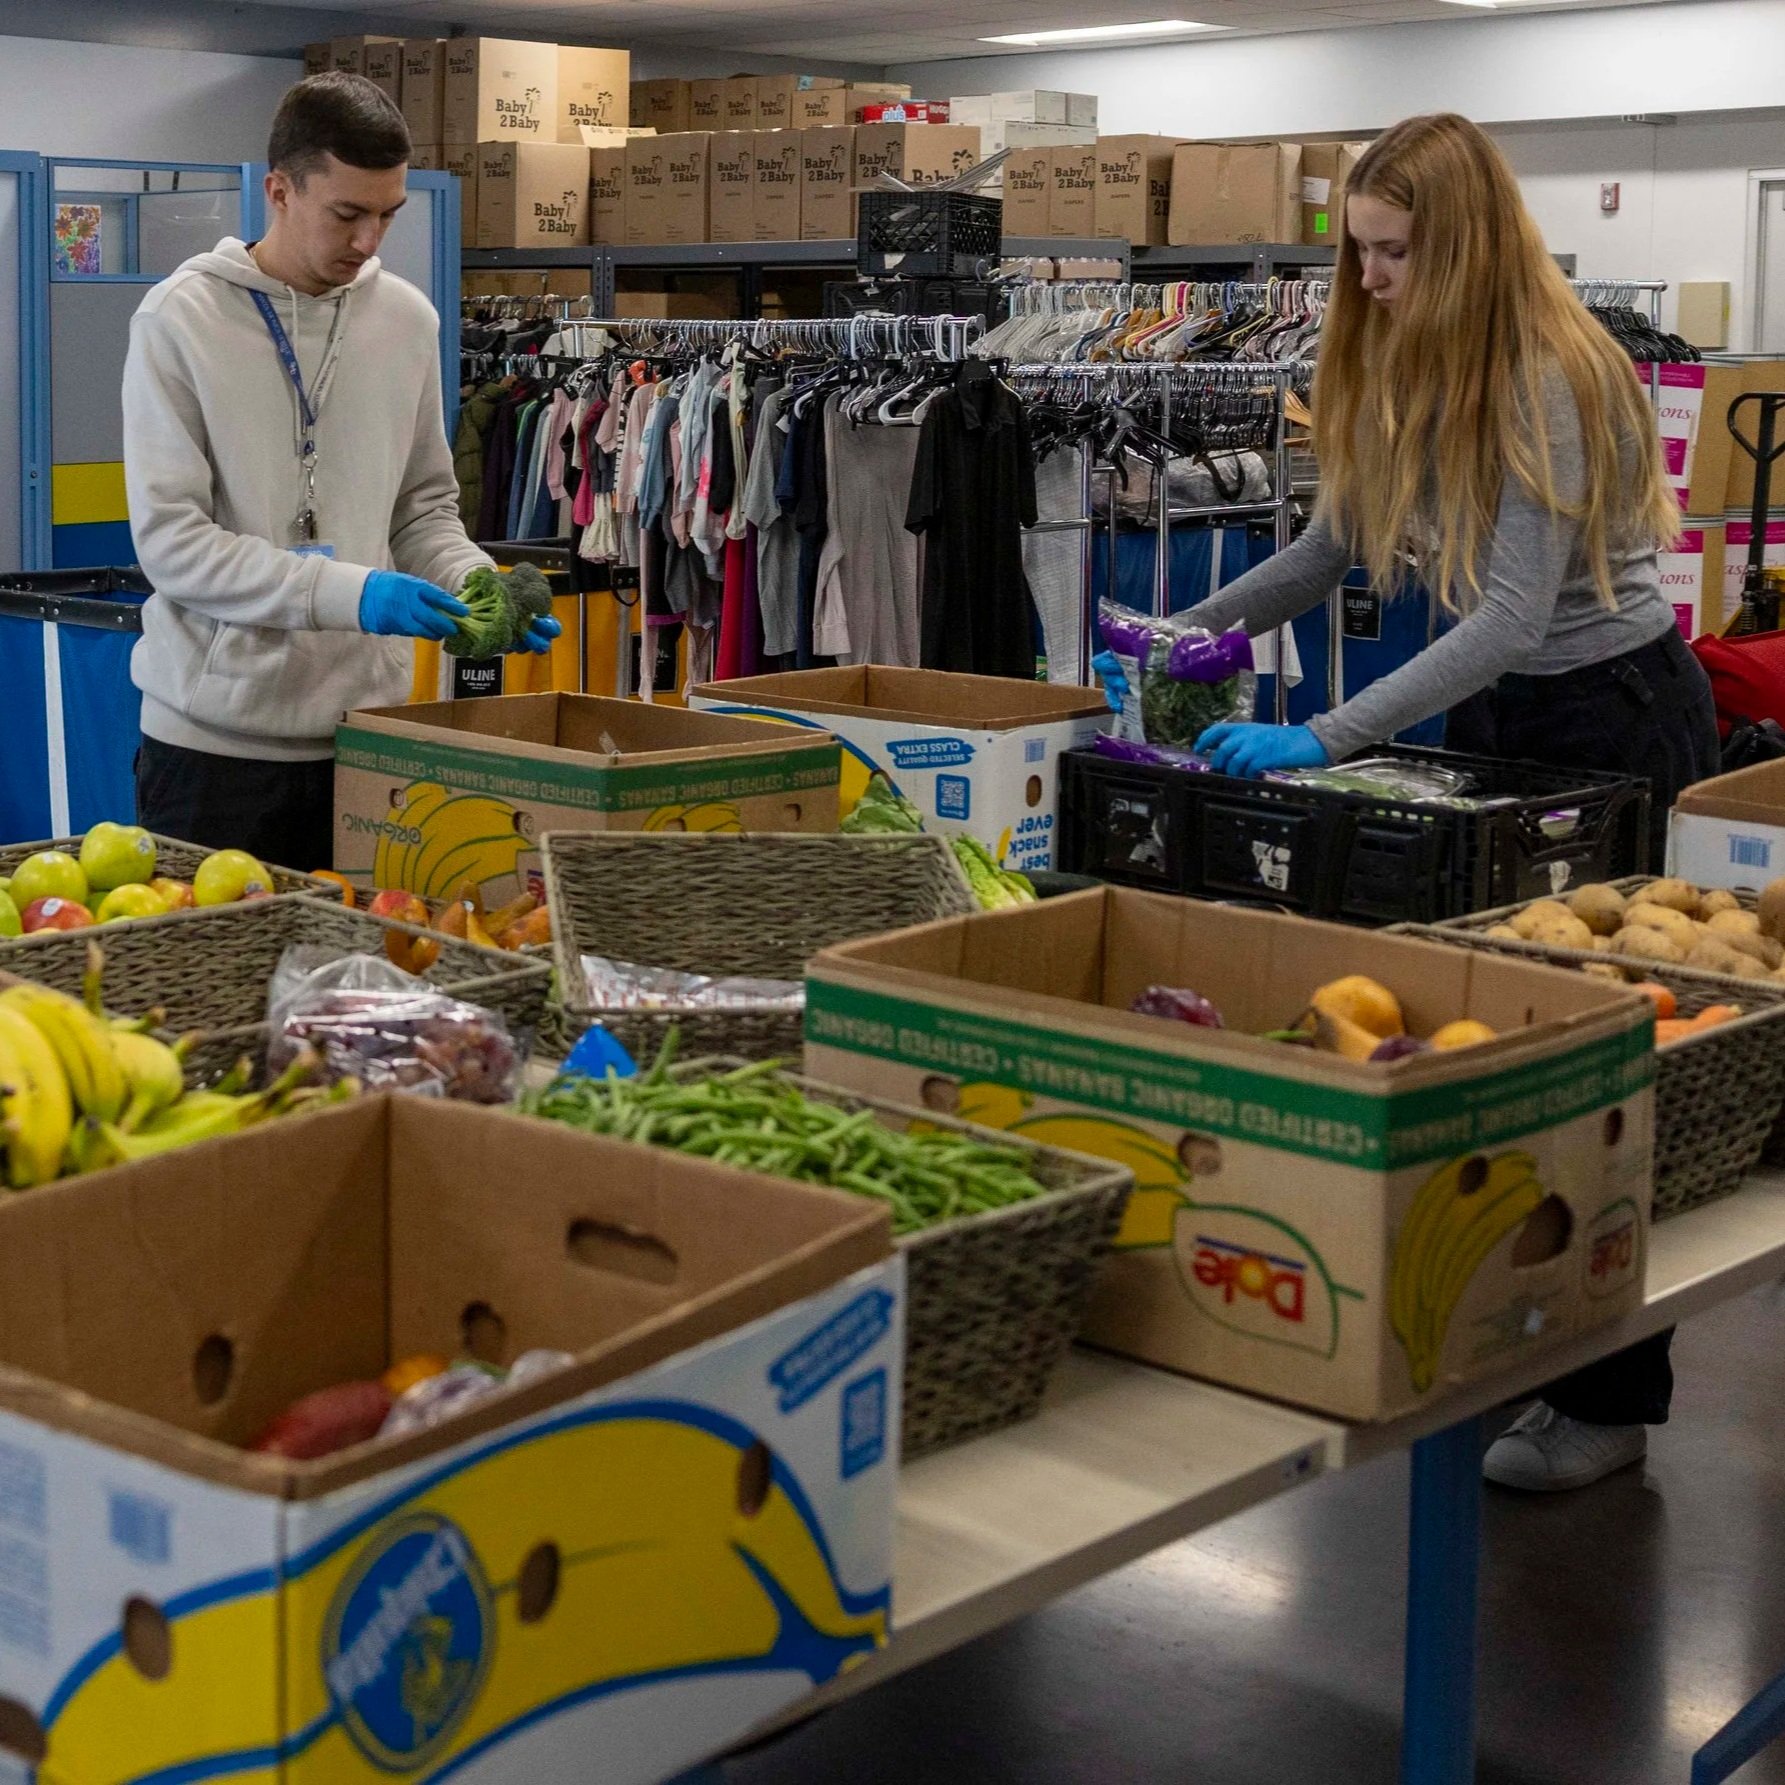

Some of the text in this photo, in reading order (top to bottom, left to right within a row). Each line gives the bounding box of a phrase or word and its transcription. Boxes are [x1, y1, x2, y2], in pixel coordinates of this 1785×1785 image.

[495, 98, 527, 117] Baby
[568, 103, 599, 120] Baby
[804, 103, 823, 111] Baby
[499, 114, 540, 132] 2Baby
[484, 161, 504, 170] Baby
[756, 159, 783, 173] Baby
[804, 157, 833, 171] Baby
[858, 153, 888, 167] Baby
[631, 165, 654, 177] Baby
[669, 163, 691, 174] Baby
[717, 162, 741, 173] Baby
[1055, 167, 1083, 179] Baby
[1100, 163, 1130, 175] Baby
[634, 175, 663, 187] 2Baby
[672, 173, 701, 184] 2Baby
[720, 172, 750, 184] 2Baby
[760, 171, 795, 184] 2Baby
[808, 170, 845, 183] 2Baby
[1009, 170, 1035, 182] Baby
[1104, 173, 1141, 185] 2Baby
[1012, 180, 1045, 191] 2Baby
[1058, 178, 1096, 190] 2Baby
[534, 203, 565, 220] Baby
[538, 219, 577, 236] 2Baby
[462, 669, 496, 681] ULINE
[896, 741, 961, 755] CLASS EXTRA
[897, 753, 965, 766] SELECTED QUALITY
[540, 782, 600, 805] CERTIFIED
[341, 813, 422, 845] ORGANIC
[1016, 814, 1053, 835] ever
[1009, 835, 1048, 858] snack
[1192, 1248, 1306, 1323] Dole
